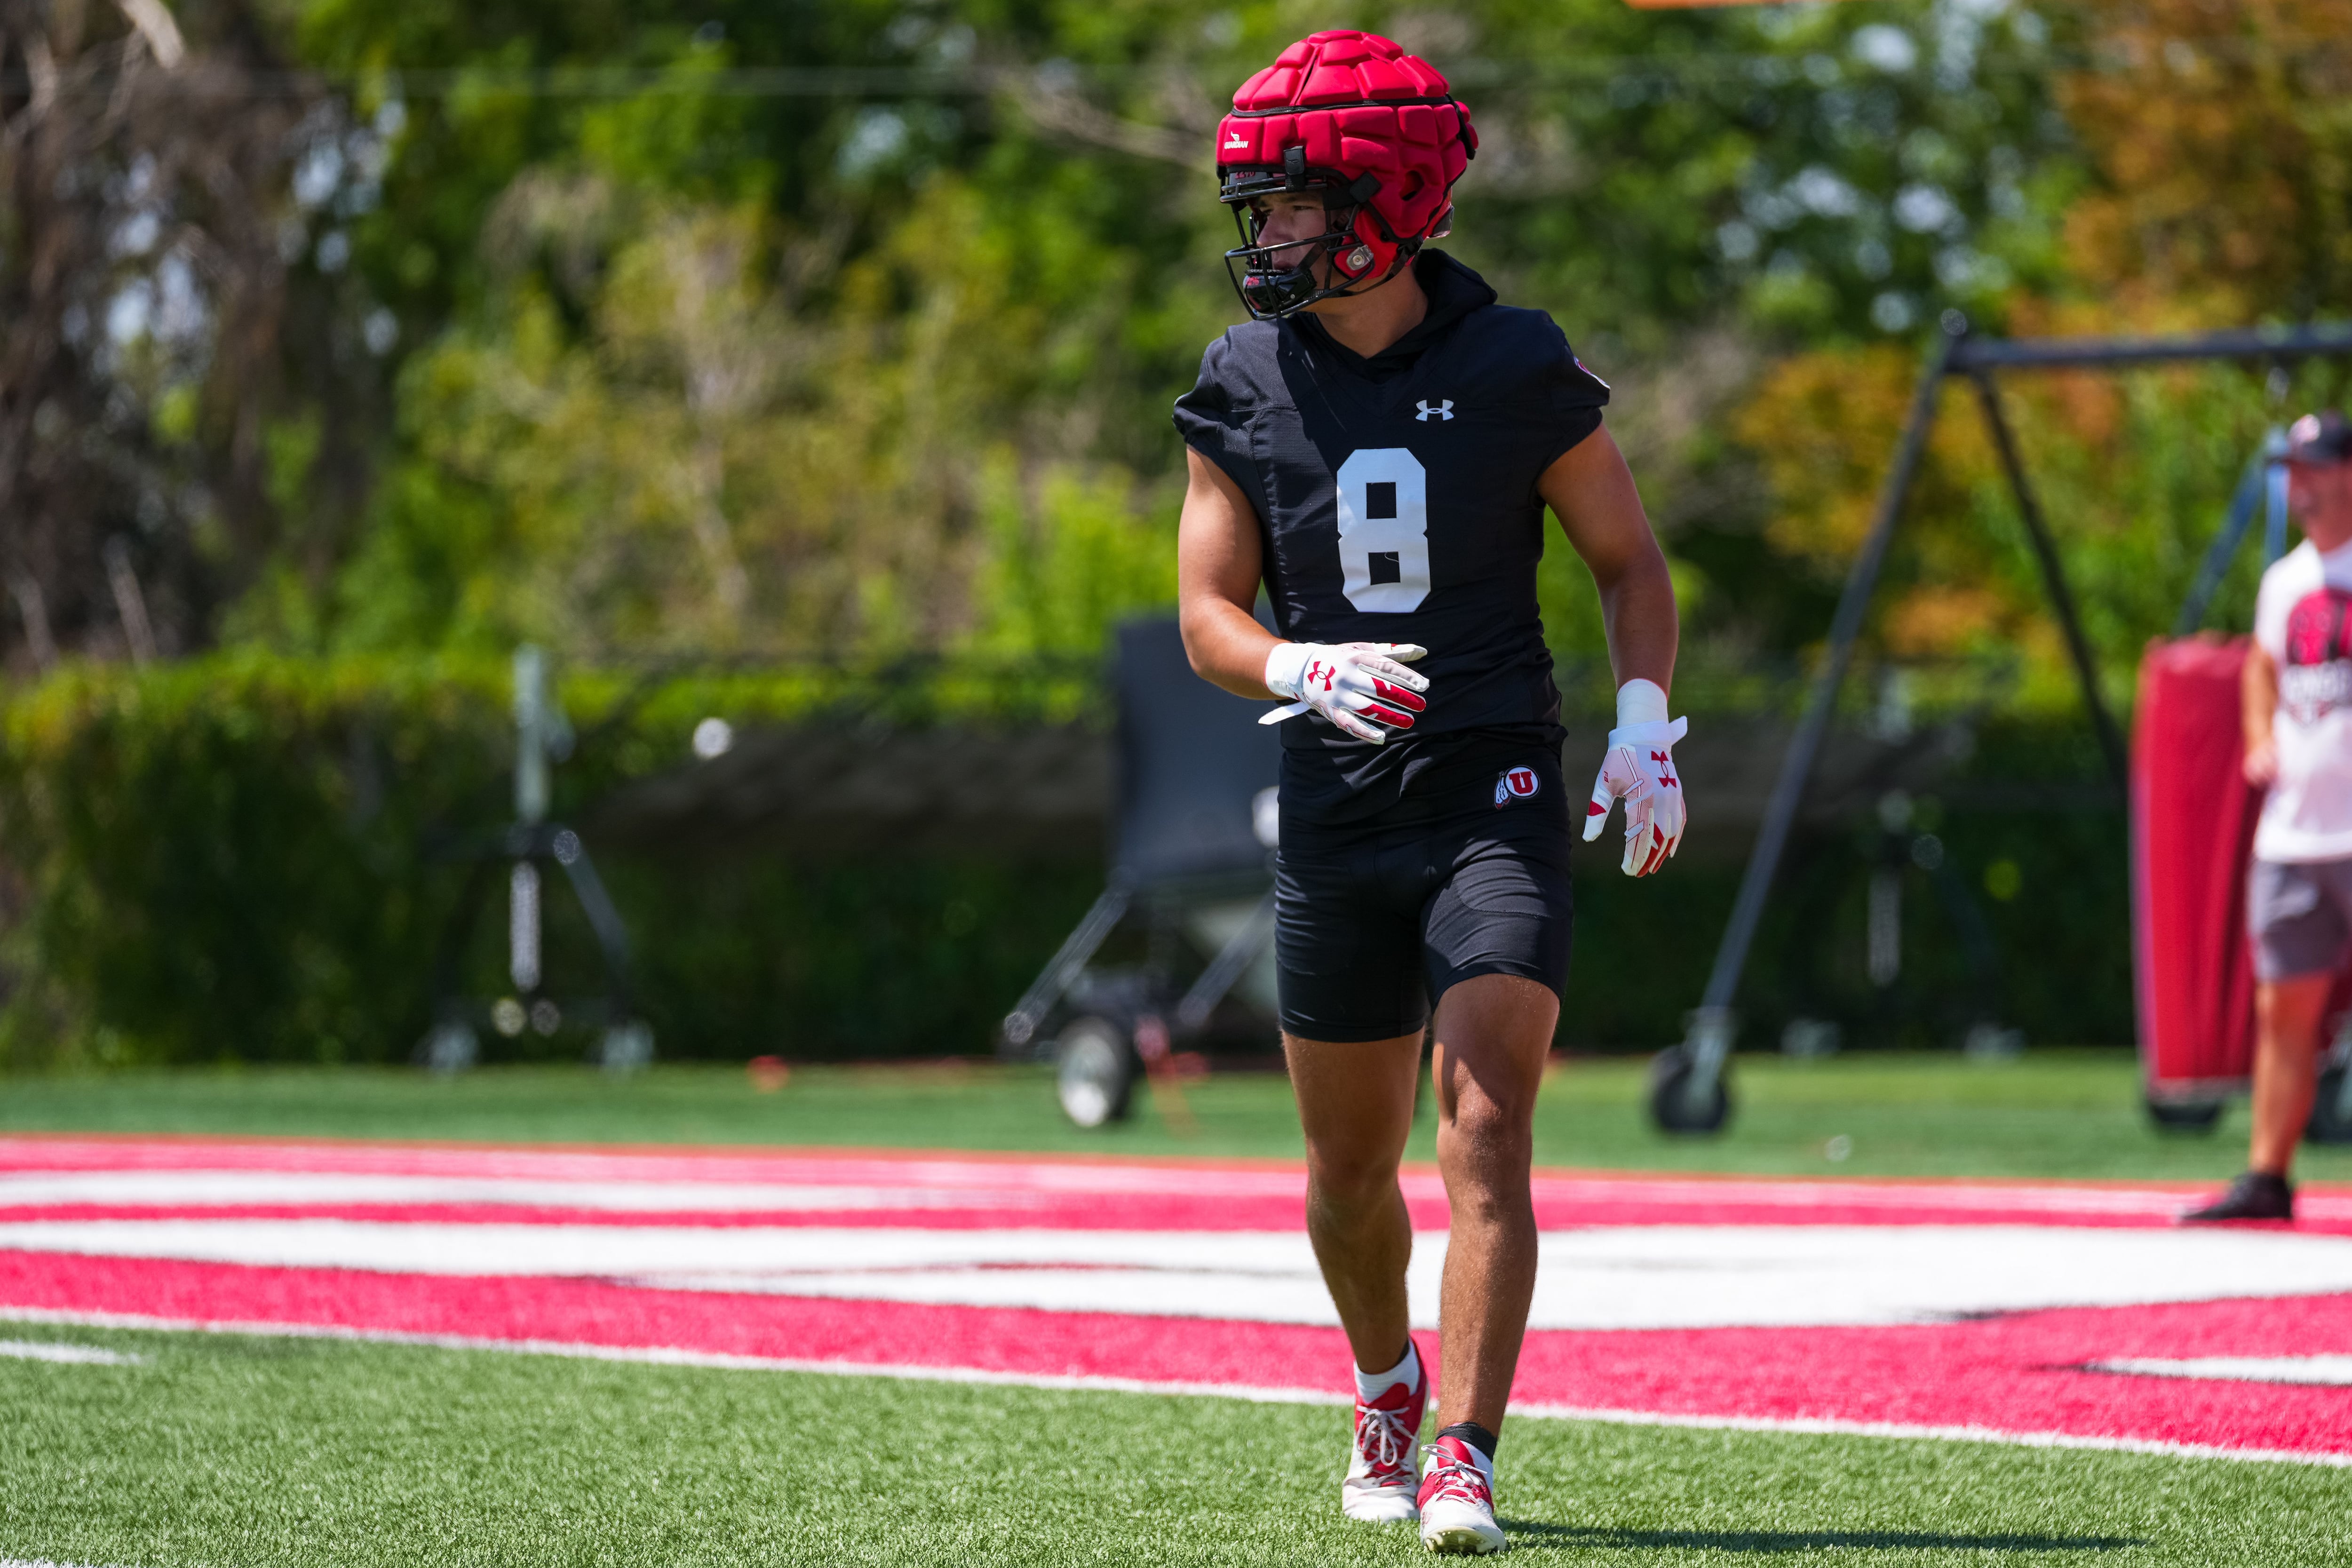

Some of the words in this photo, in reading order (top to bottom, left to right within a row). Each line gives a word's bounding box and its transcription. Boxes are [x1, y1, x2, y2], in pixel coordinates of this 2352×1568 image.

[1224, 141, 1249, 149] GUARDIAN
[1336, 447, 1431, 613] 8
[1508, 771, 1534, 794] U
